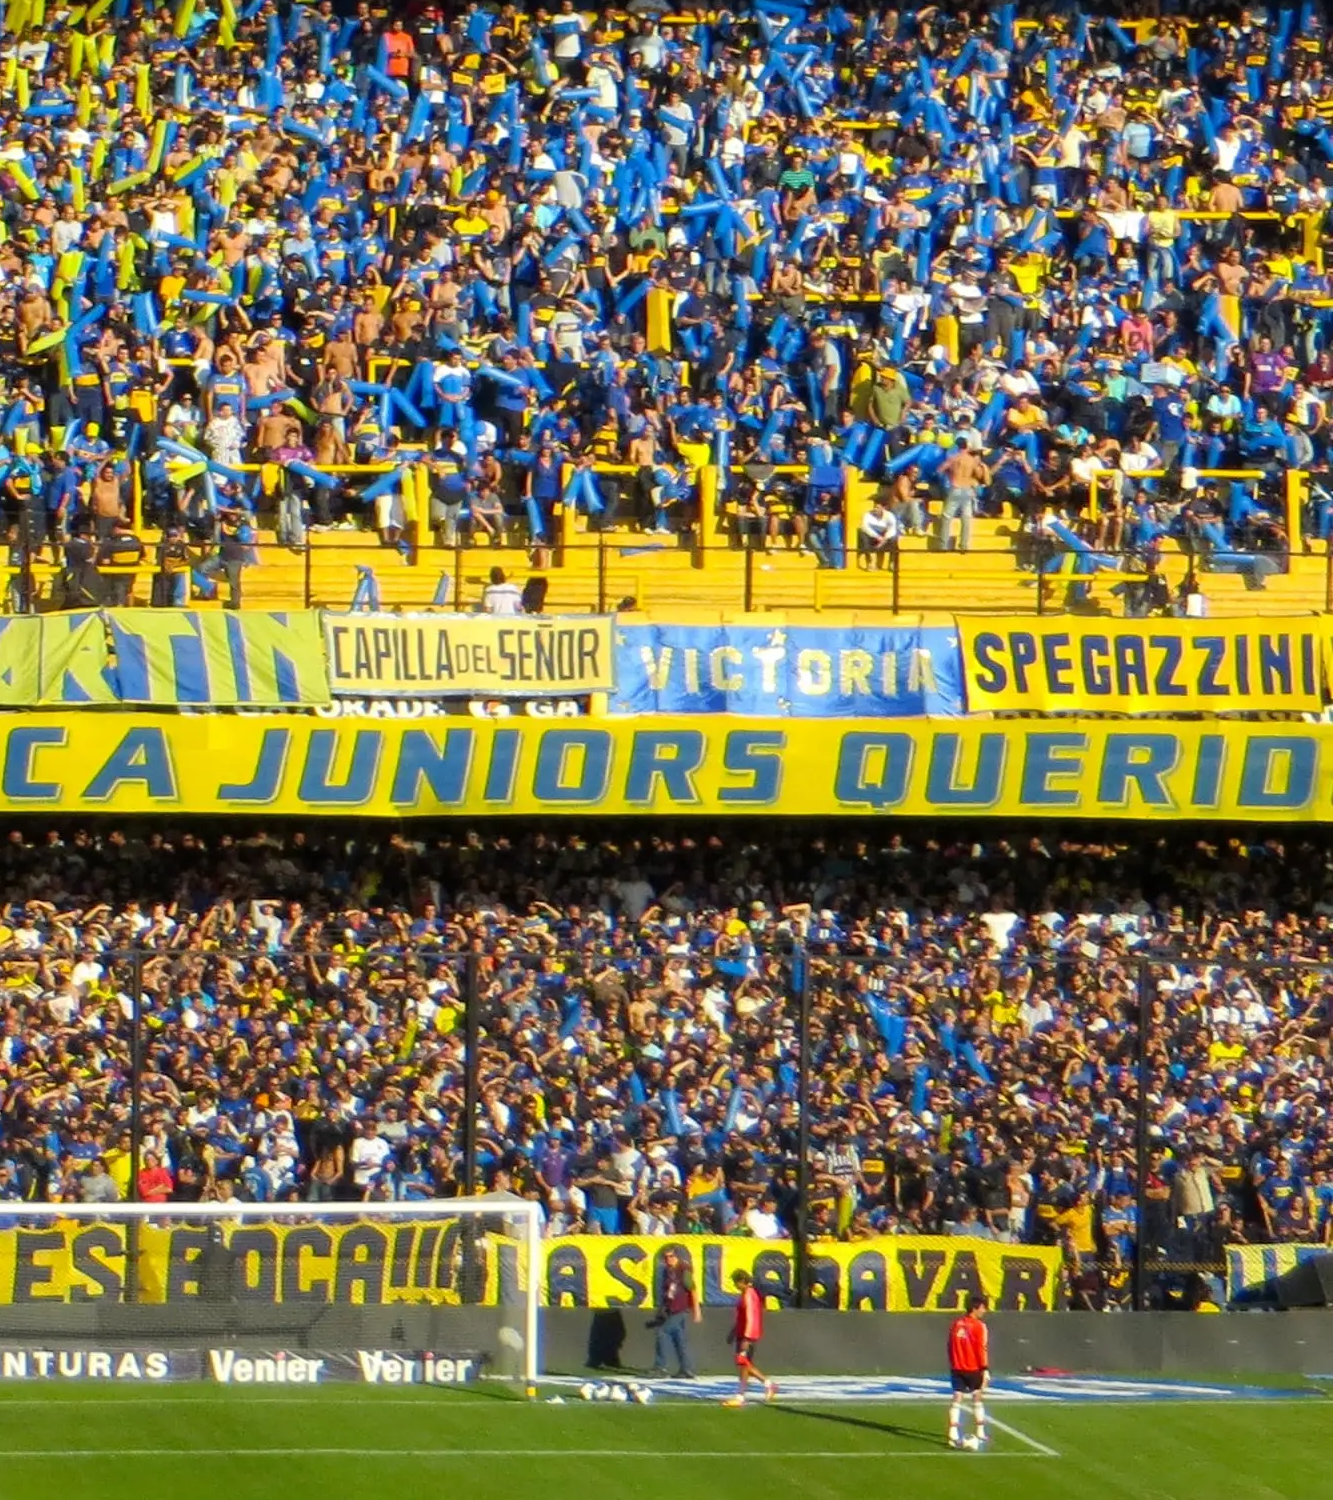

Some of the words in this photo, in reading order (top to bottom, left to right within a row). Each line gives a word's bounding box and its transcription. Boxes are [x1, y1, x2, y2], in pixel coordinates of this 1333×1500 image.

[334, 628, 453, 681] CAPILLA
[456, 642, 499, 675] DEL
[498, 623, 600, 682] SEÑOR
[641, 644, 937, 696] VICTORIA
[973, 631, 1317, 697] SPEGAZZINI
[217, 727, 788, 808] JUNIORS
[833, 730, 1333, 814] QUERID
[209, 1350, 324, 1383] Venier
